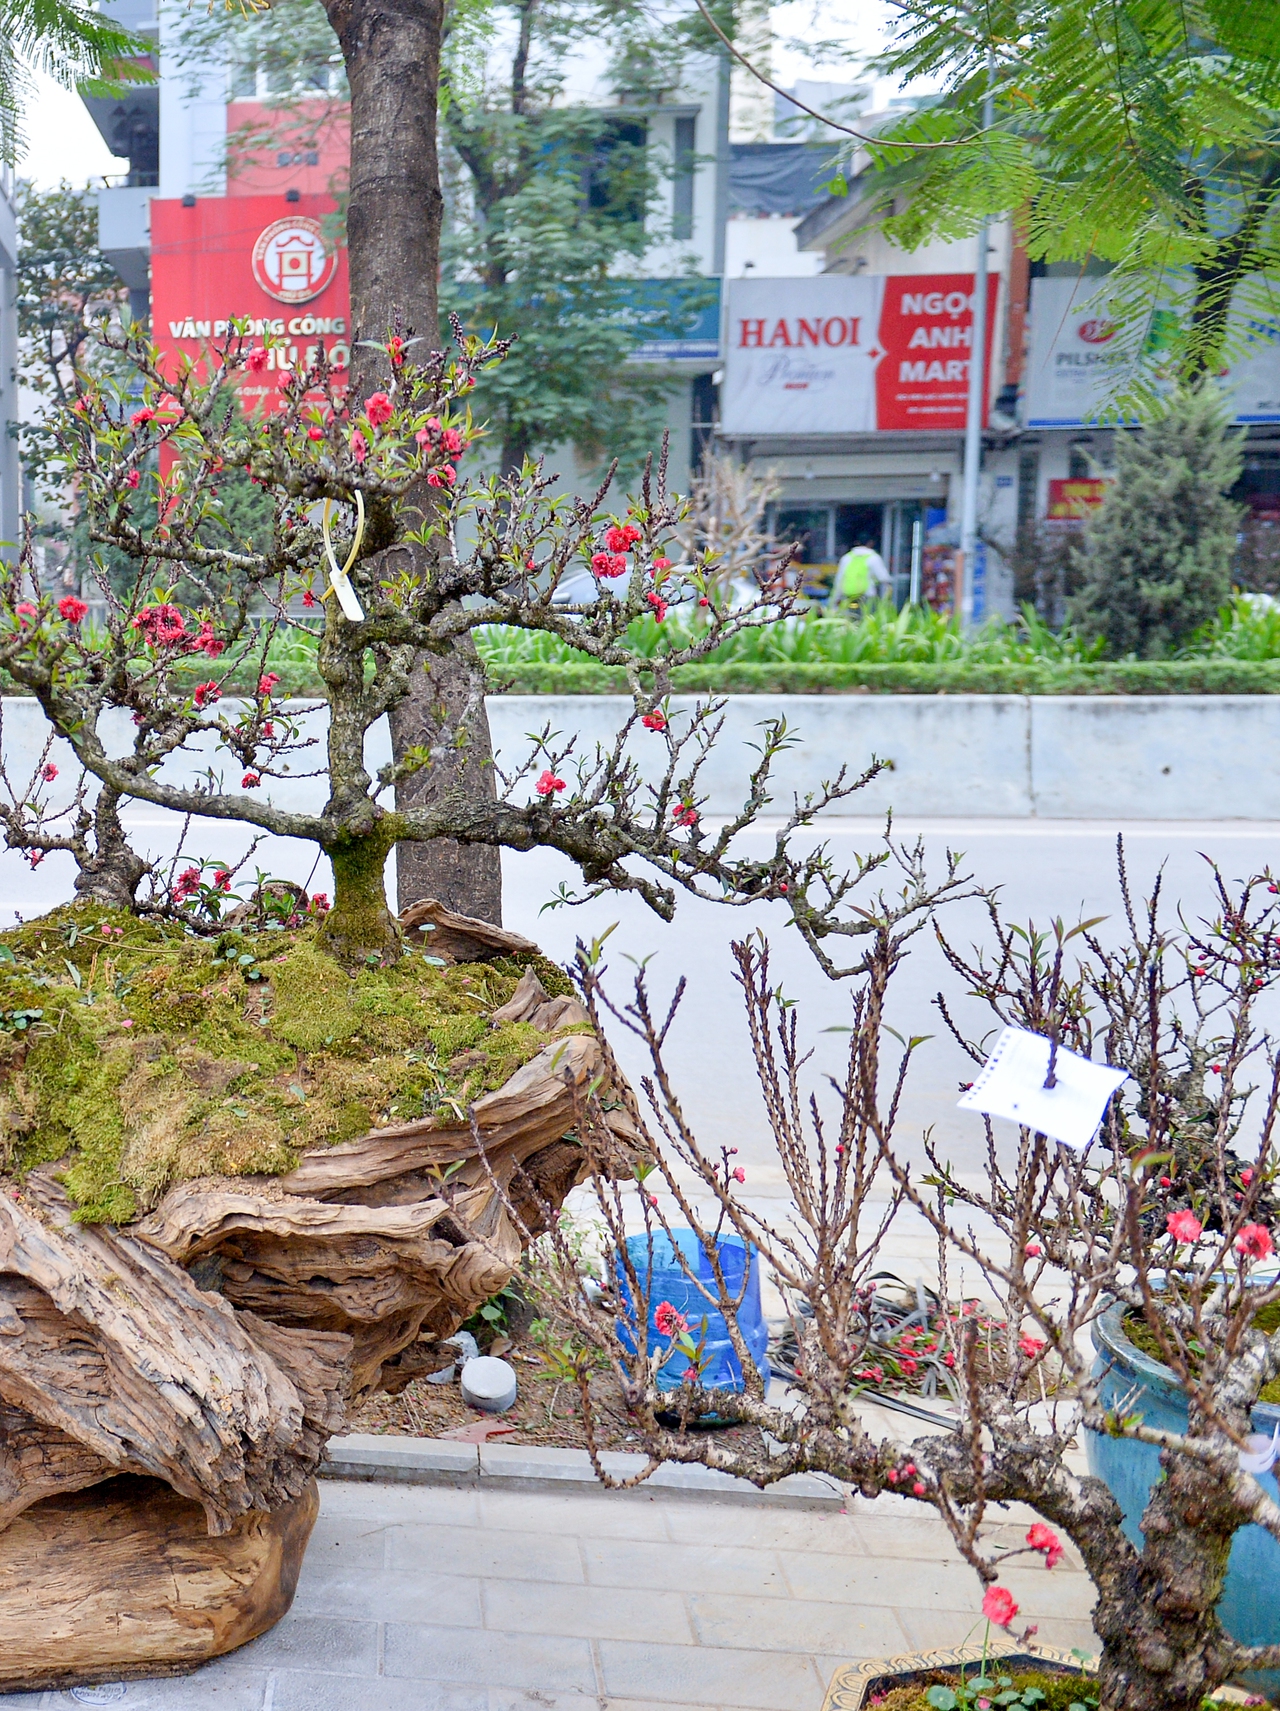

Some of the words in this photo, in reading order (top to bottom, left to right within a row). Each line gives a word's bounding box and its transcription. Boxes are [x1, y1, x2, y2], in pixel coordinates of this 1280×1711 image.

[169, 316, 211, 339] VĂN
[288, 313, 346, 335] CÔNG
[738, 316, 862, 348] HANOI
[908, 326, 970, 349] ANH
